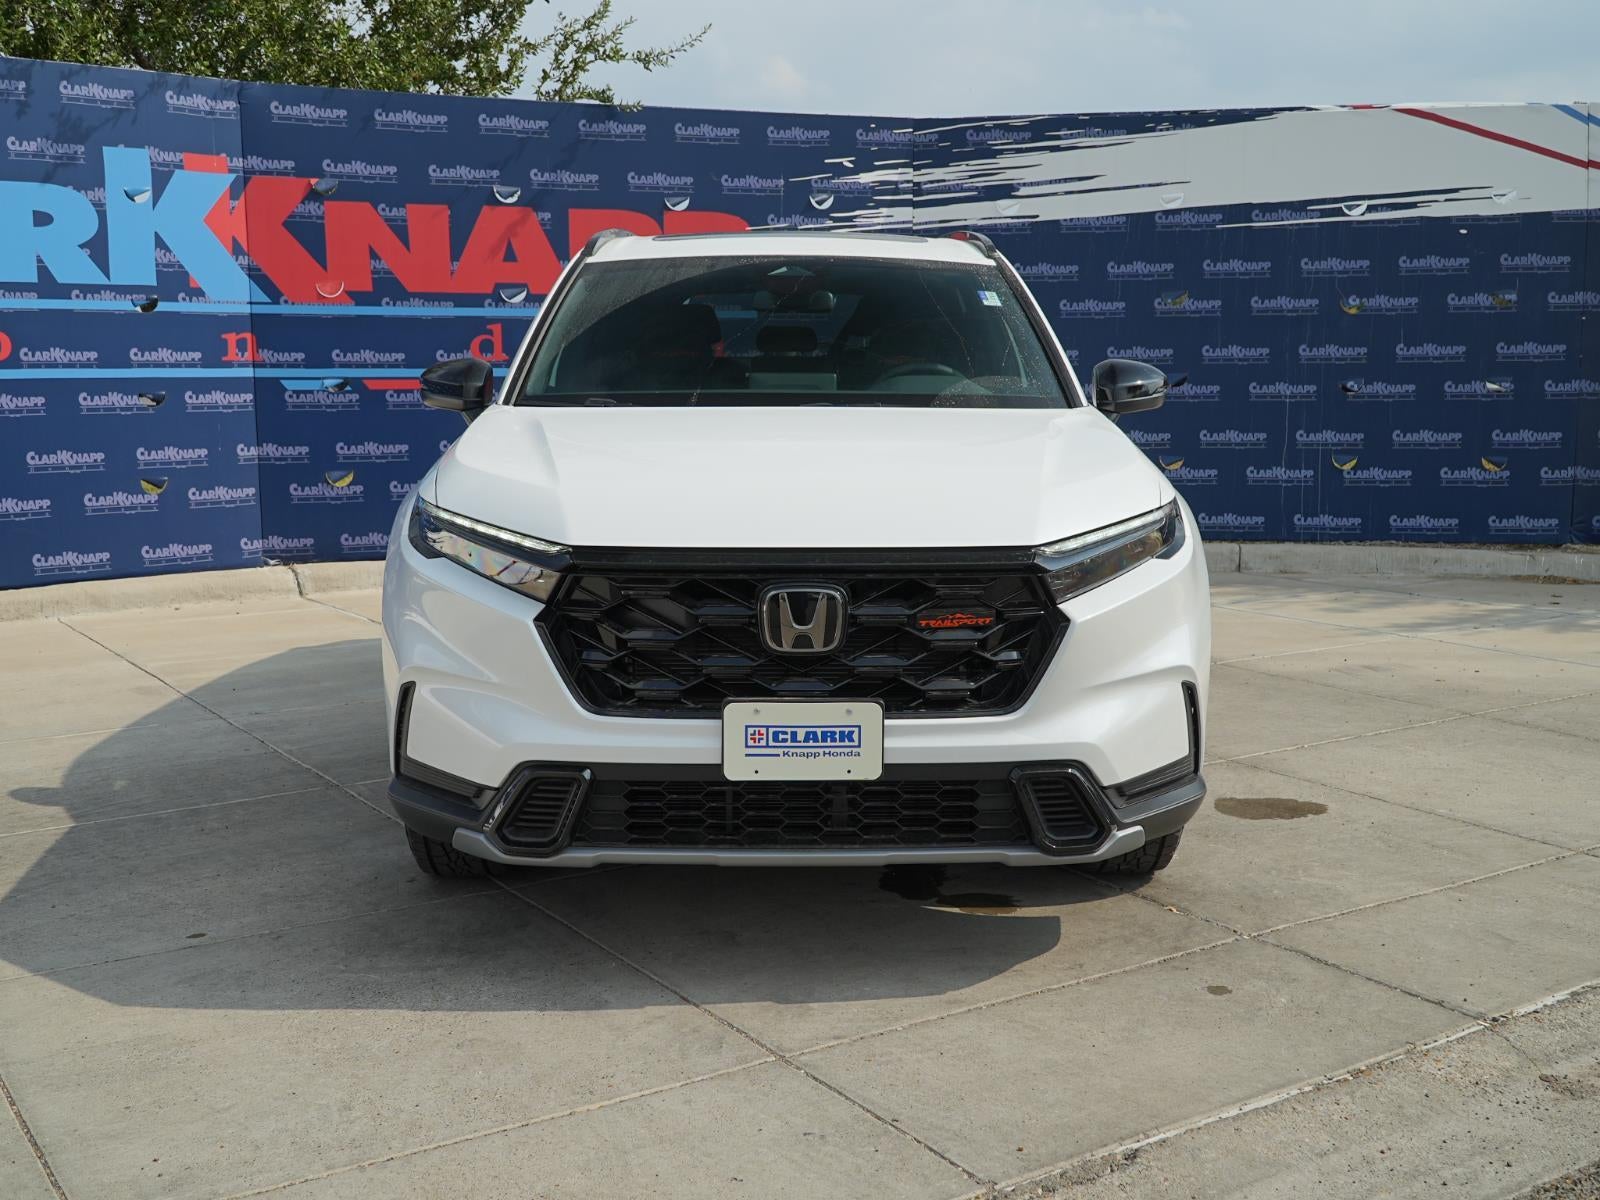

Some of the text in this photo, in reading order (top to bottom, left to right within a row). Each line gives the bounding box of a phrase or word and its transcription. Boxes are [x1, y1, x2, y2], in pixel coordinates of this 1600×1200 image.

[919, 617, 992, 629] TRAILSPORT
[771, 730, 856, 744] CLARK
[782, 750, 861, 759] Knapp Honda
